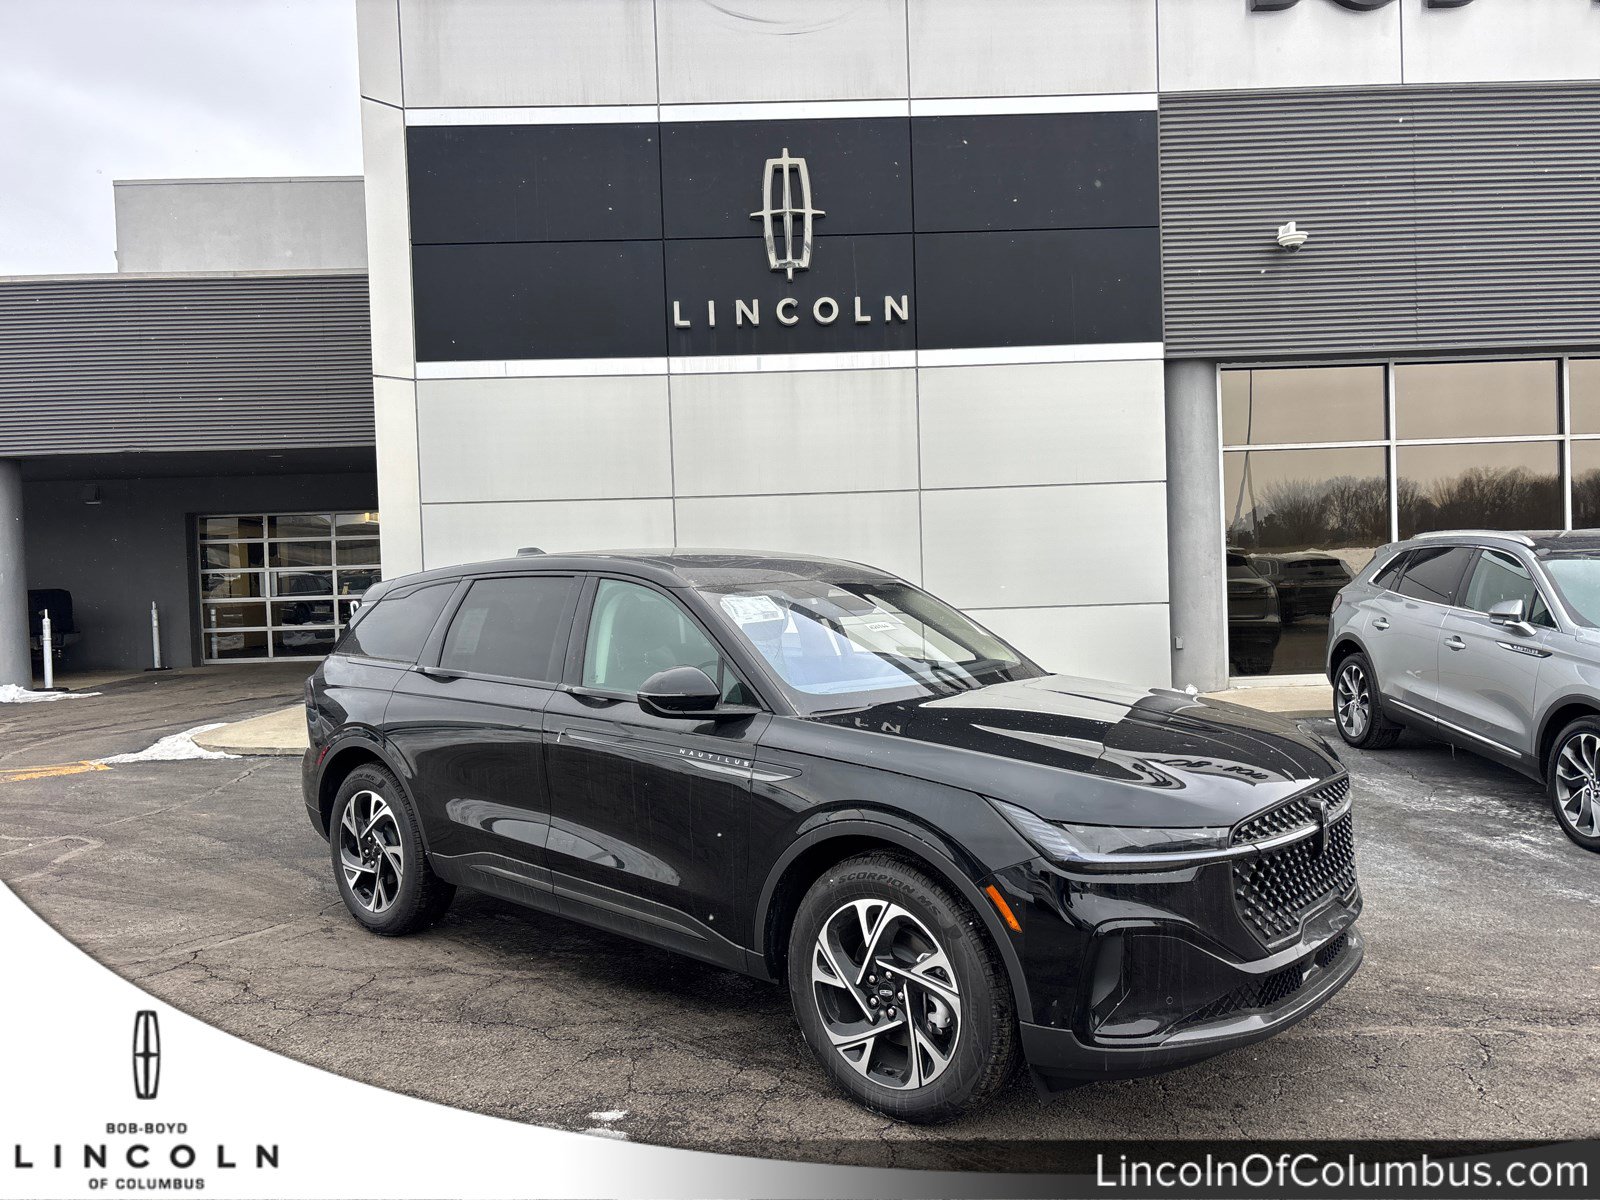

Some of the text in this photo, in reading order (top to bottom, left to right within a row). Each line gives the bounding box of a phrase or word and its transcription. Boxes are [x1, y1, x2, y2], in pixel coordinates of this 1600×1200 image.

[673, 294, 909, 329] LINCOLN
[679, 748, 750, 767] NAUTILUS
[838, 871, 916, 895] SCORPION
